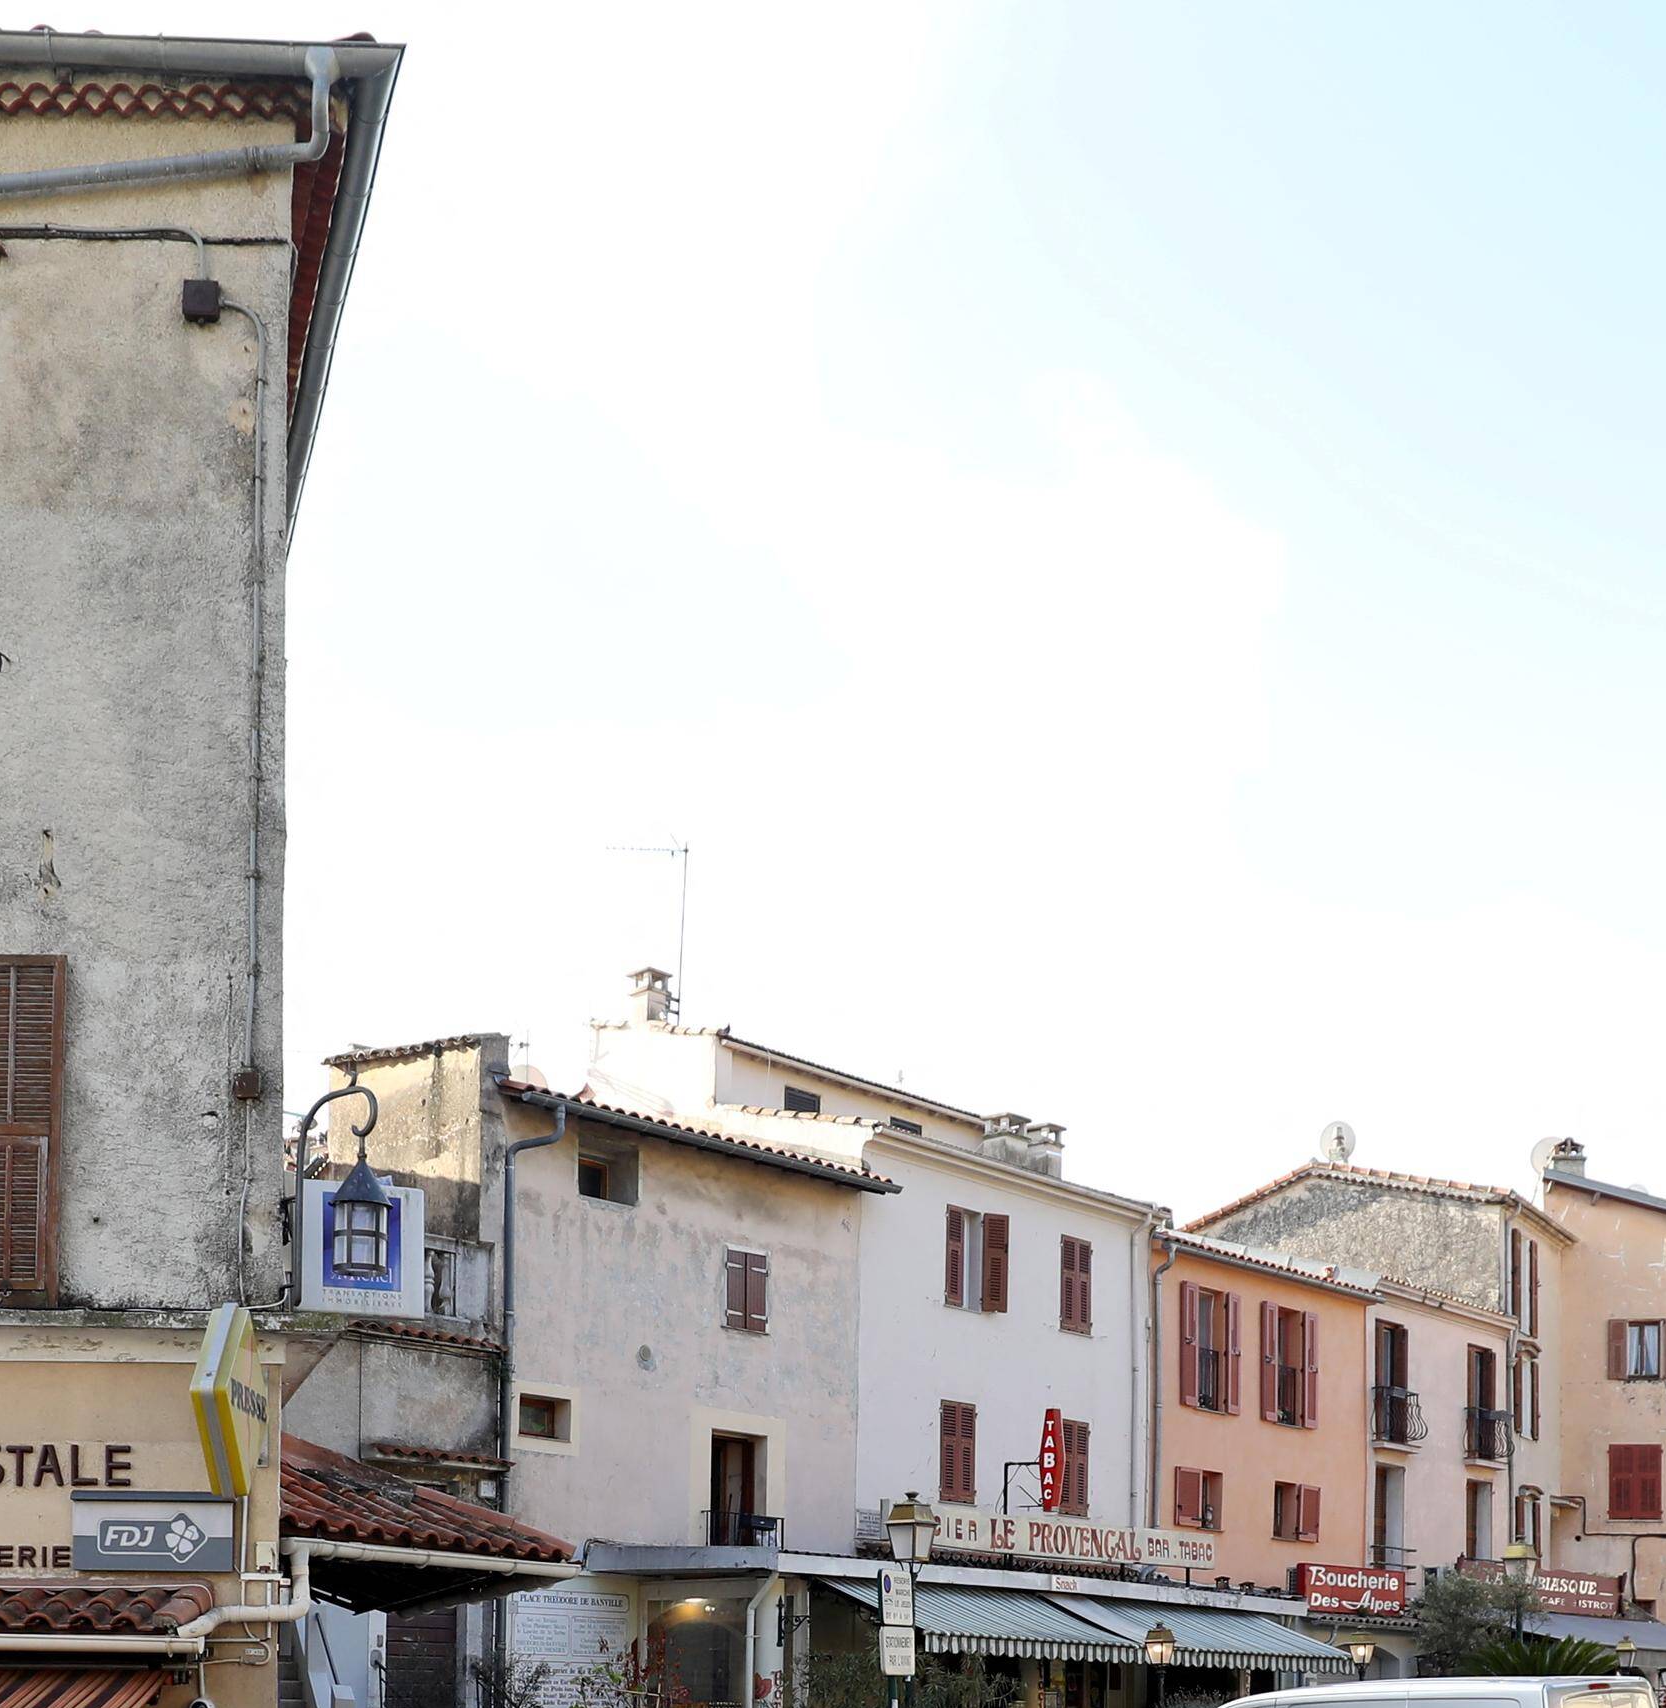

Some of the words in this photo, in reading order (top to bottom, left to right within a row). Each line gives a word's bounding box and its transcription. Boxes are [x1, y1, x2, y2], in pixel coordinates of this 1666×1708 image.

[230, 1376, 268, 1423] PRESSE
[1043, 1420, 1055, 1499] TABAC
[104, 1525, 155, 1548] FDJ
[990, 1518, 1015, 1550] LE
[1029, 1521, 1142, 1562] PROVENÇAL
[1147, 1537, 1170, 1558] BAR
[1179, 1541, 1213, 1561] TABAC
[1309, 1565, 1399, 1591] Boucherie
[1311, 1592, 1339, 1608] Des
[1341, 1590, 1400, 1613] Alpes
